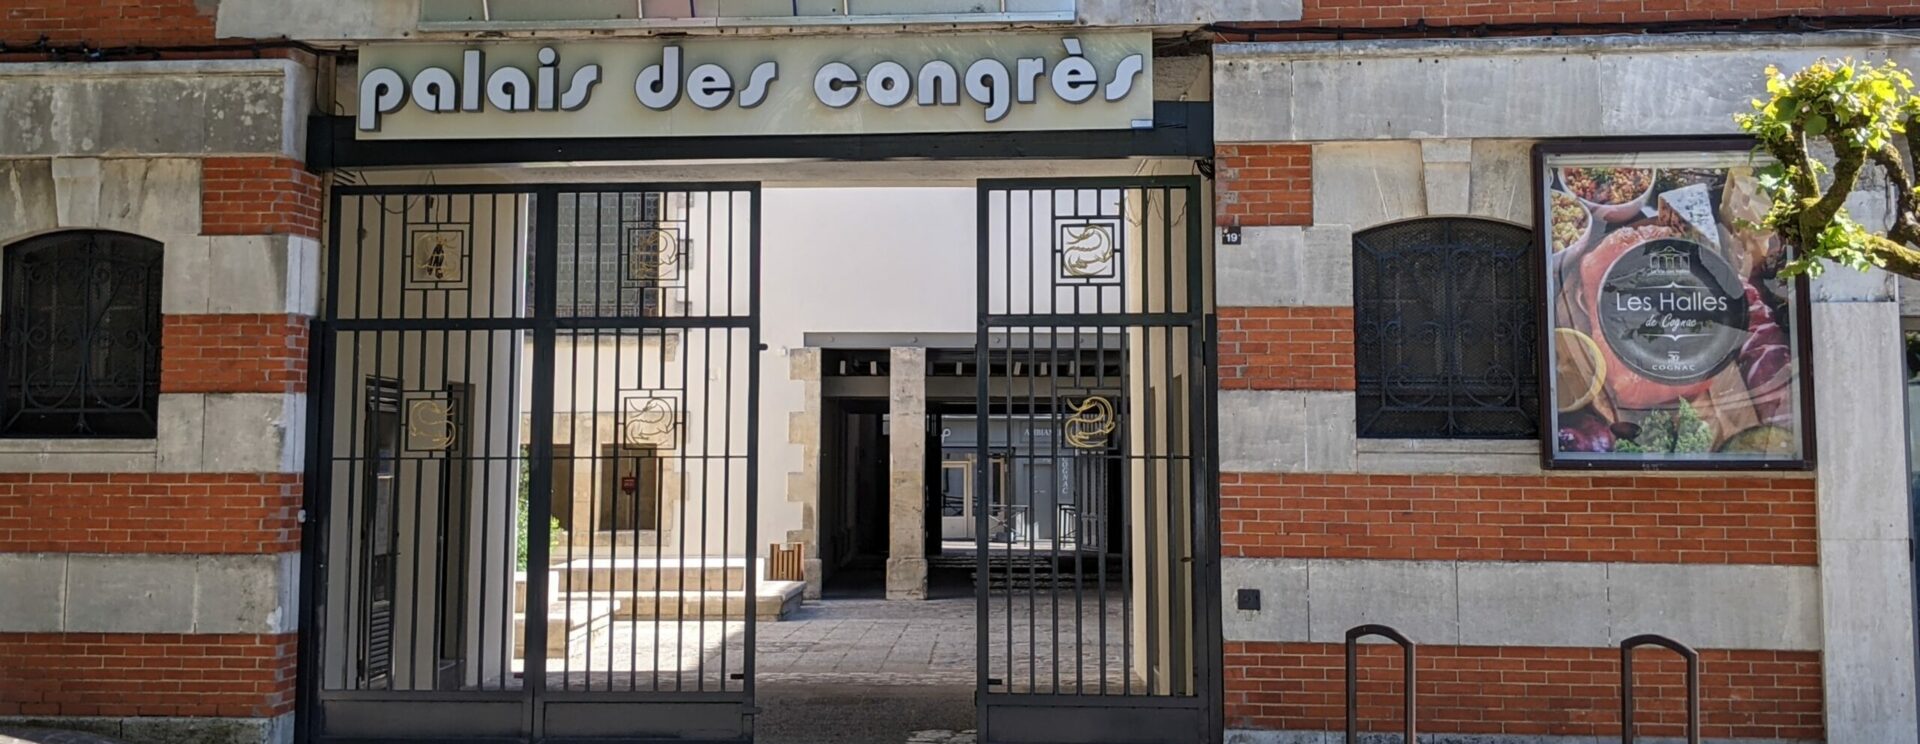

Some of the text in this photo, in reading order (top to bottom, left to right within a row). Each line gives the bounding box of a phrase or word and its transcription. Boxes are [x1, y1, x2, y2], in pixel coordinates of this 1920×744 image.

[359, 37, 1143, 132] palais des congrès
[1226, 232, 1238, 243] 19
[1616, 292, 1728, 311] Les Halles
[1645, 313, 1697, 332] de Cognac
